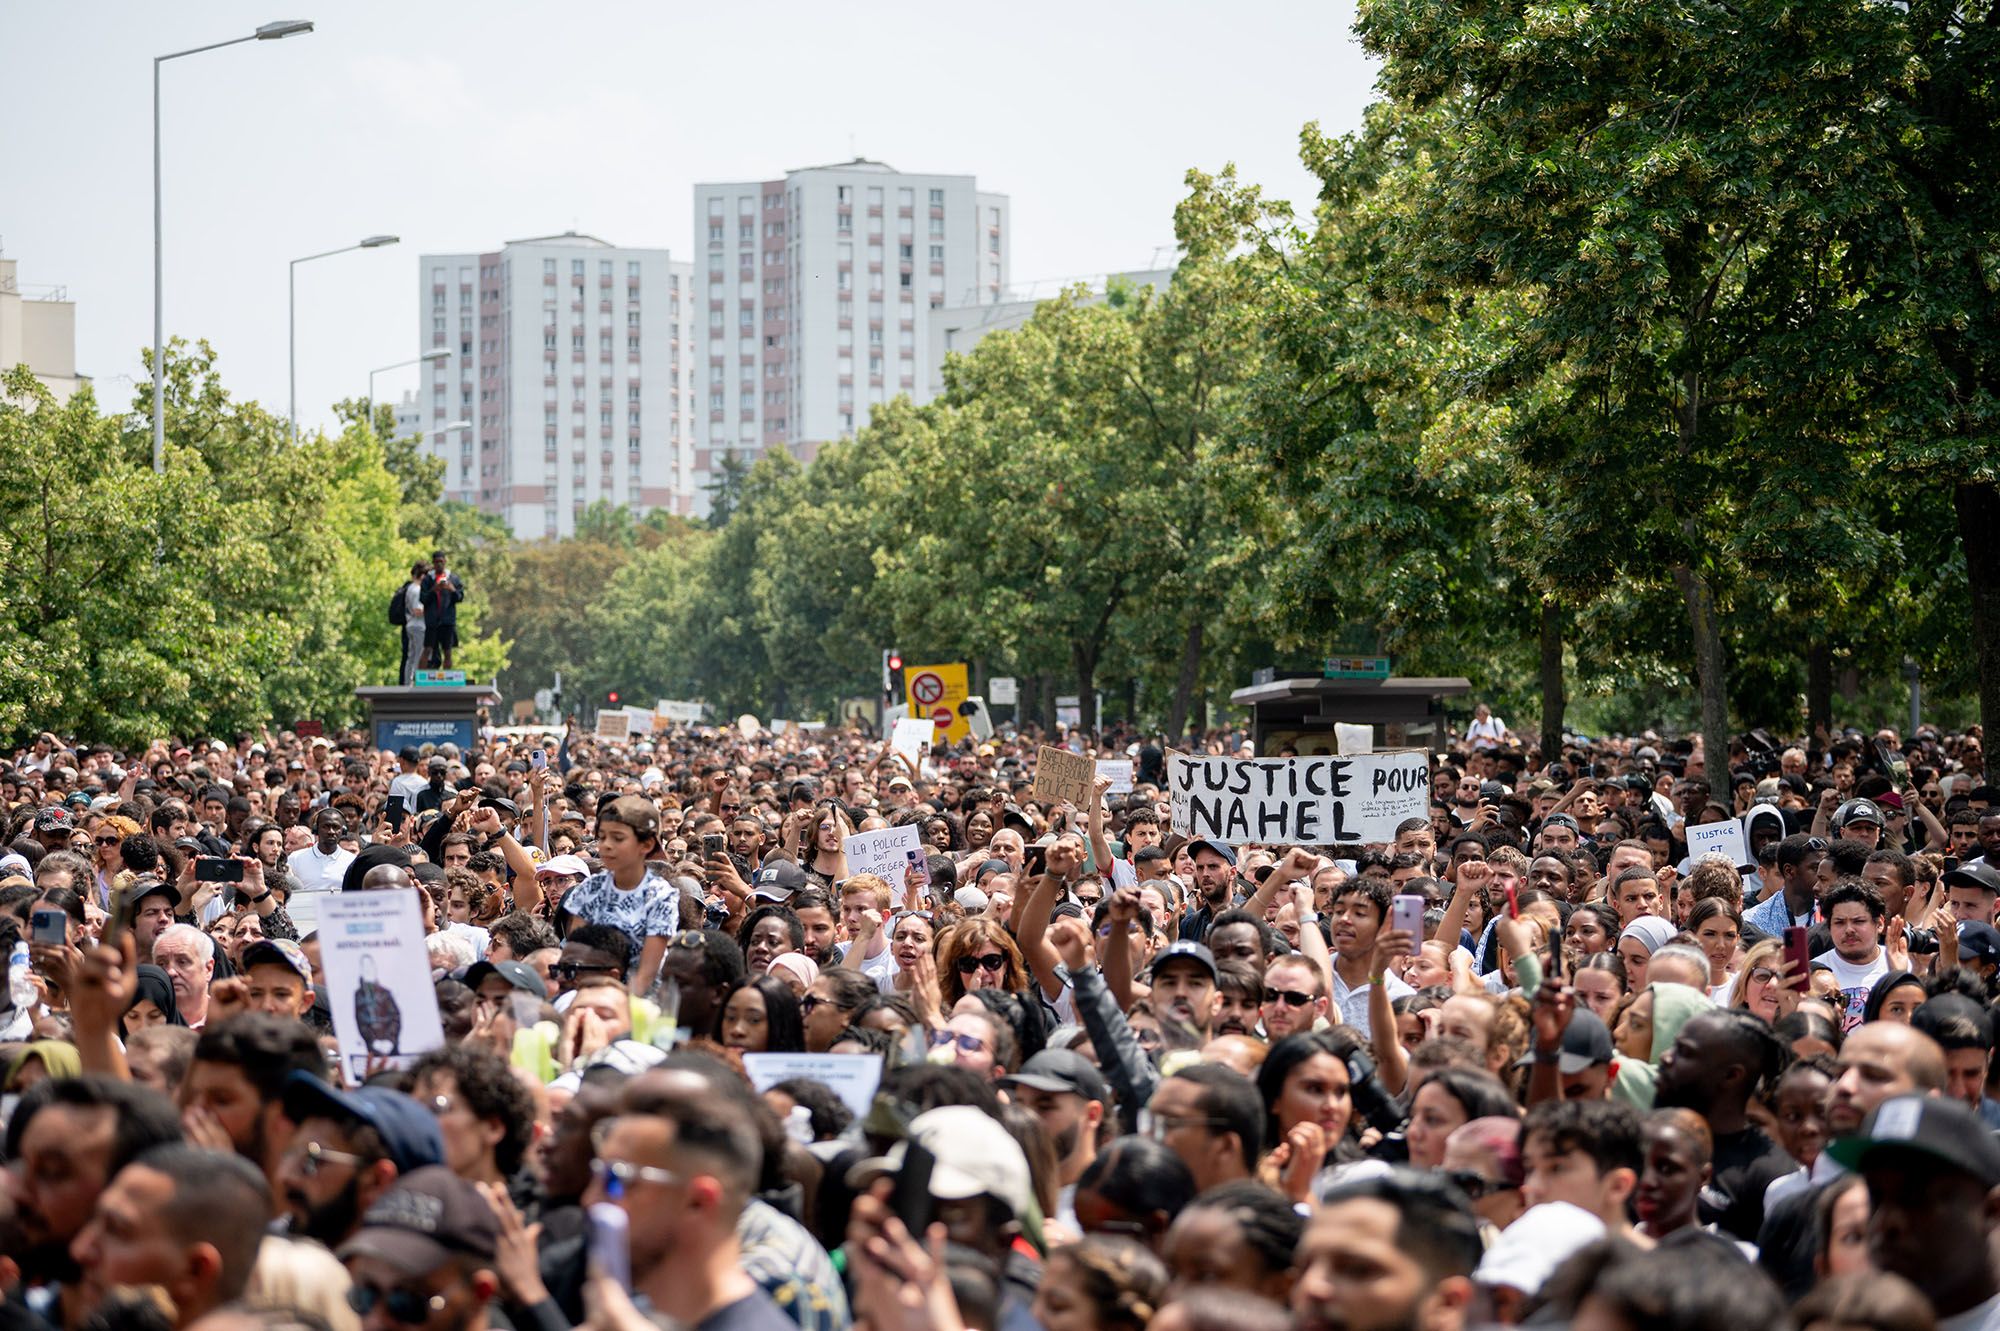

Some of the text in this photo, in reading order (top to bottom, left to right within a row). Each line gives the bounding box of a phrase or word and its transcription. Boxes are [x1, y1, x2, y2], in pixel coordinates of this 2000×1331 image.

[1036, 776, 1074, 800] POLICE
[1372, 765, 1429, 797] POUR
[1190, 794, 1362, 842] NAHEL
[1696, 827, 1735, 840] JUSTICE
[852, 835, 909, 856] LA POLICE
[859, 860, 906, 874] PROTEGER
[873, 851, 891, 862] DOIT
